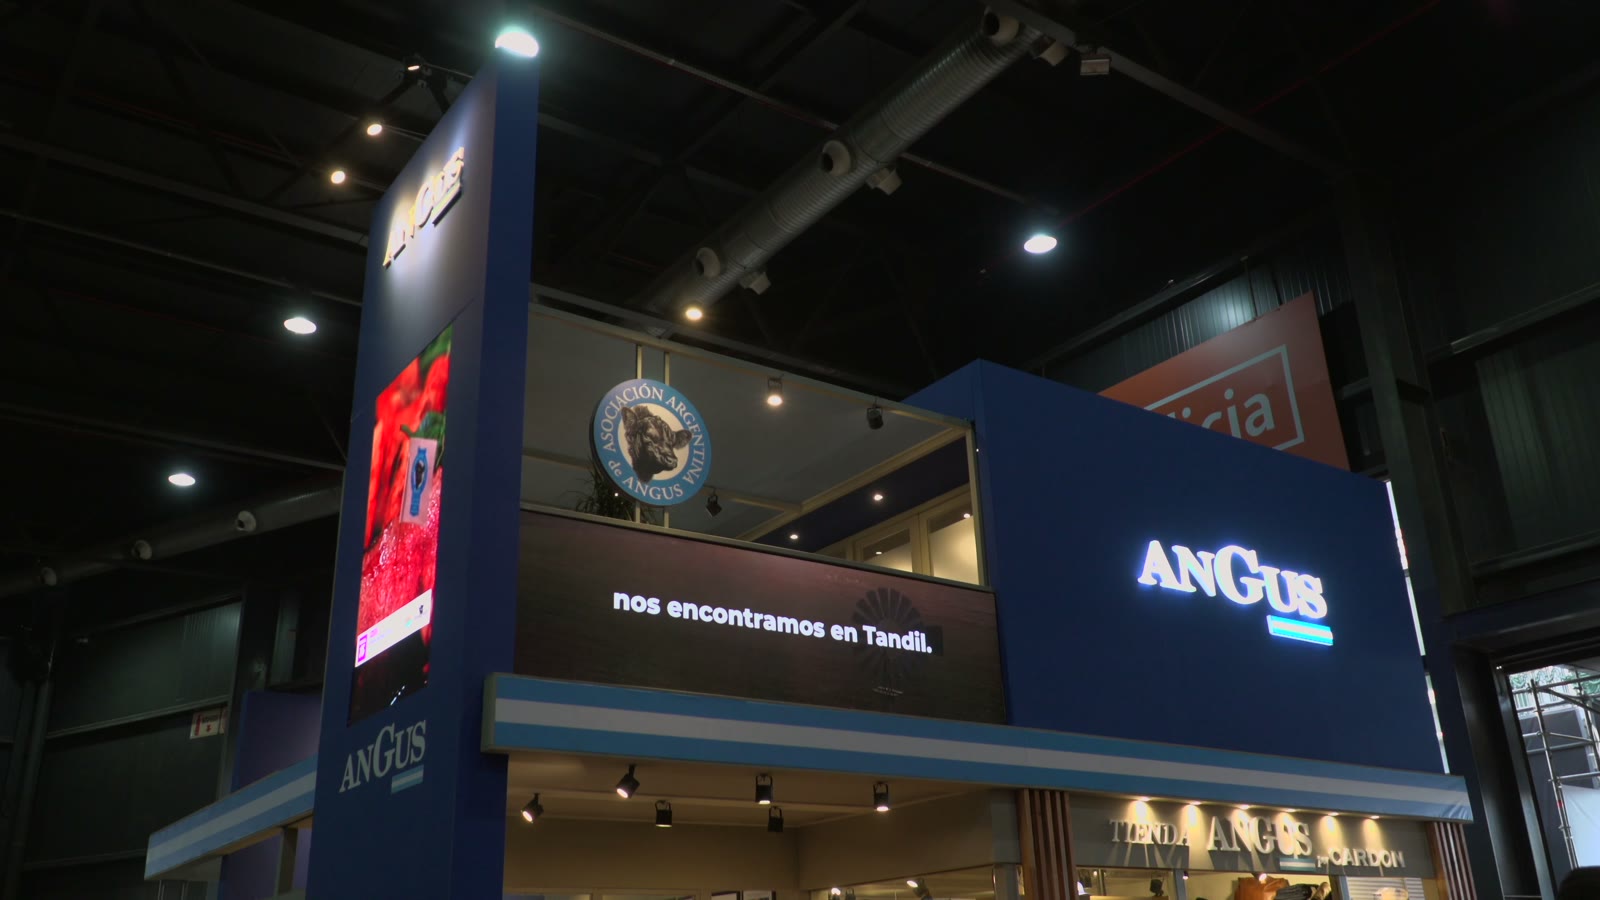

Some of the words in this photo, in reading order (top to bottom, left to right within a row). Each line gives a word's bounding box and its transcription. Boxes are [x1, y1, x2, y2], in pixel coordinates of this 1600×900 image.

[600, 383, 664, 453] ASOCIACIÓN
[665, 396, 705, 485] ARGENTINA
[608, 460, 622, 477] de
[622, 476, 684, 500] ANGUS
[1137, 540, 1328, 619] ANGUS
[613, 591, 661, 615] nos
[667, 600, 825, 638] encontramos
[830, 624, 858, 643] en
[862, 624, 933, 654] Tandil.
[339, 719, 427, 792] ANGUS
[1109, 818, 1190, 846] TIENDA
[1207, 815, 1313, 857] ANGUS
